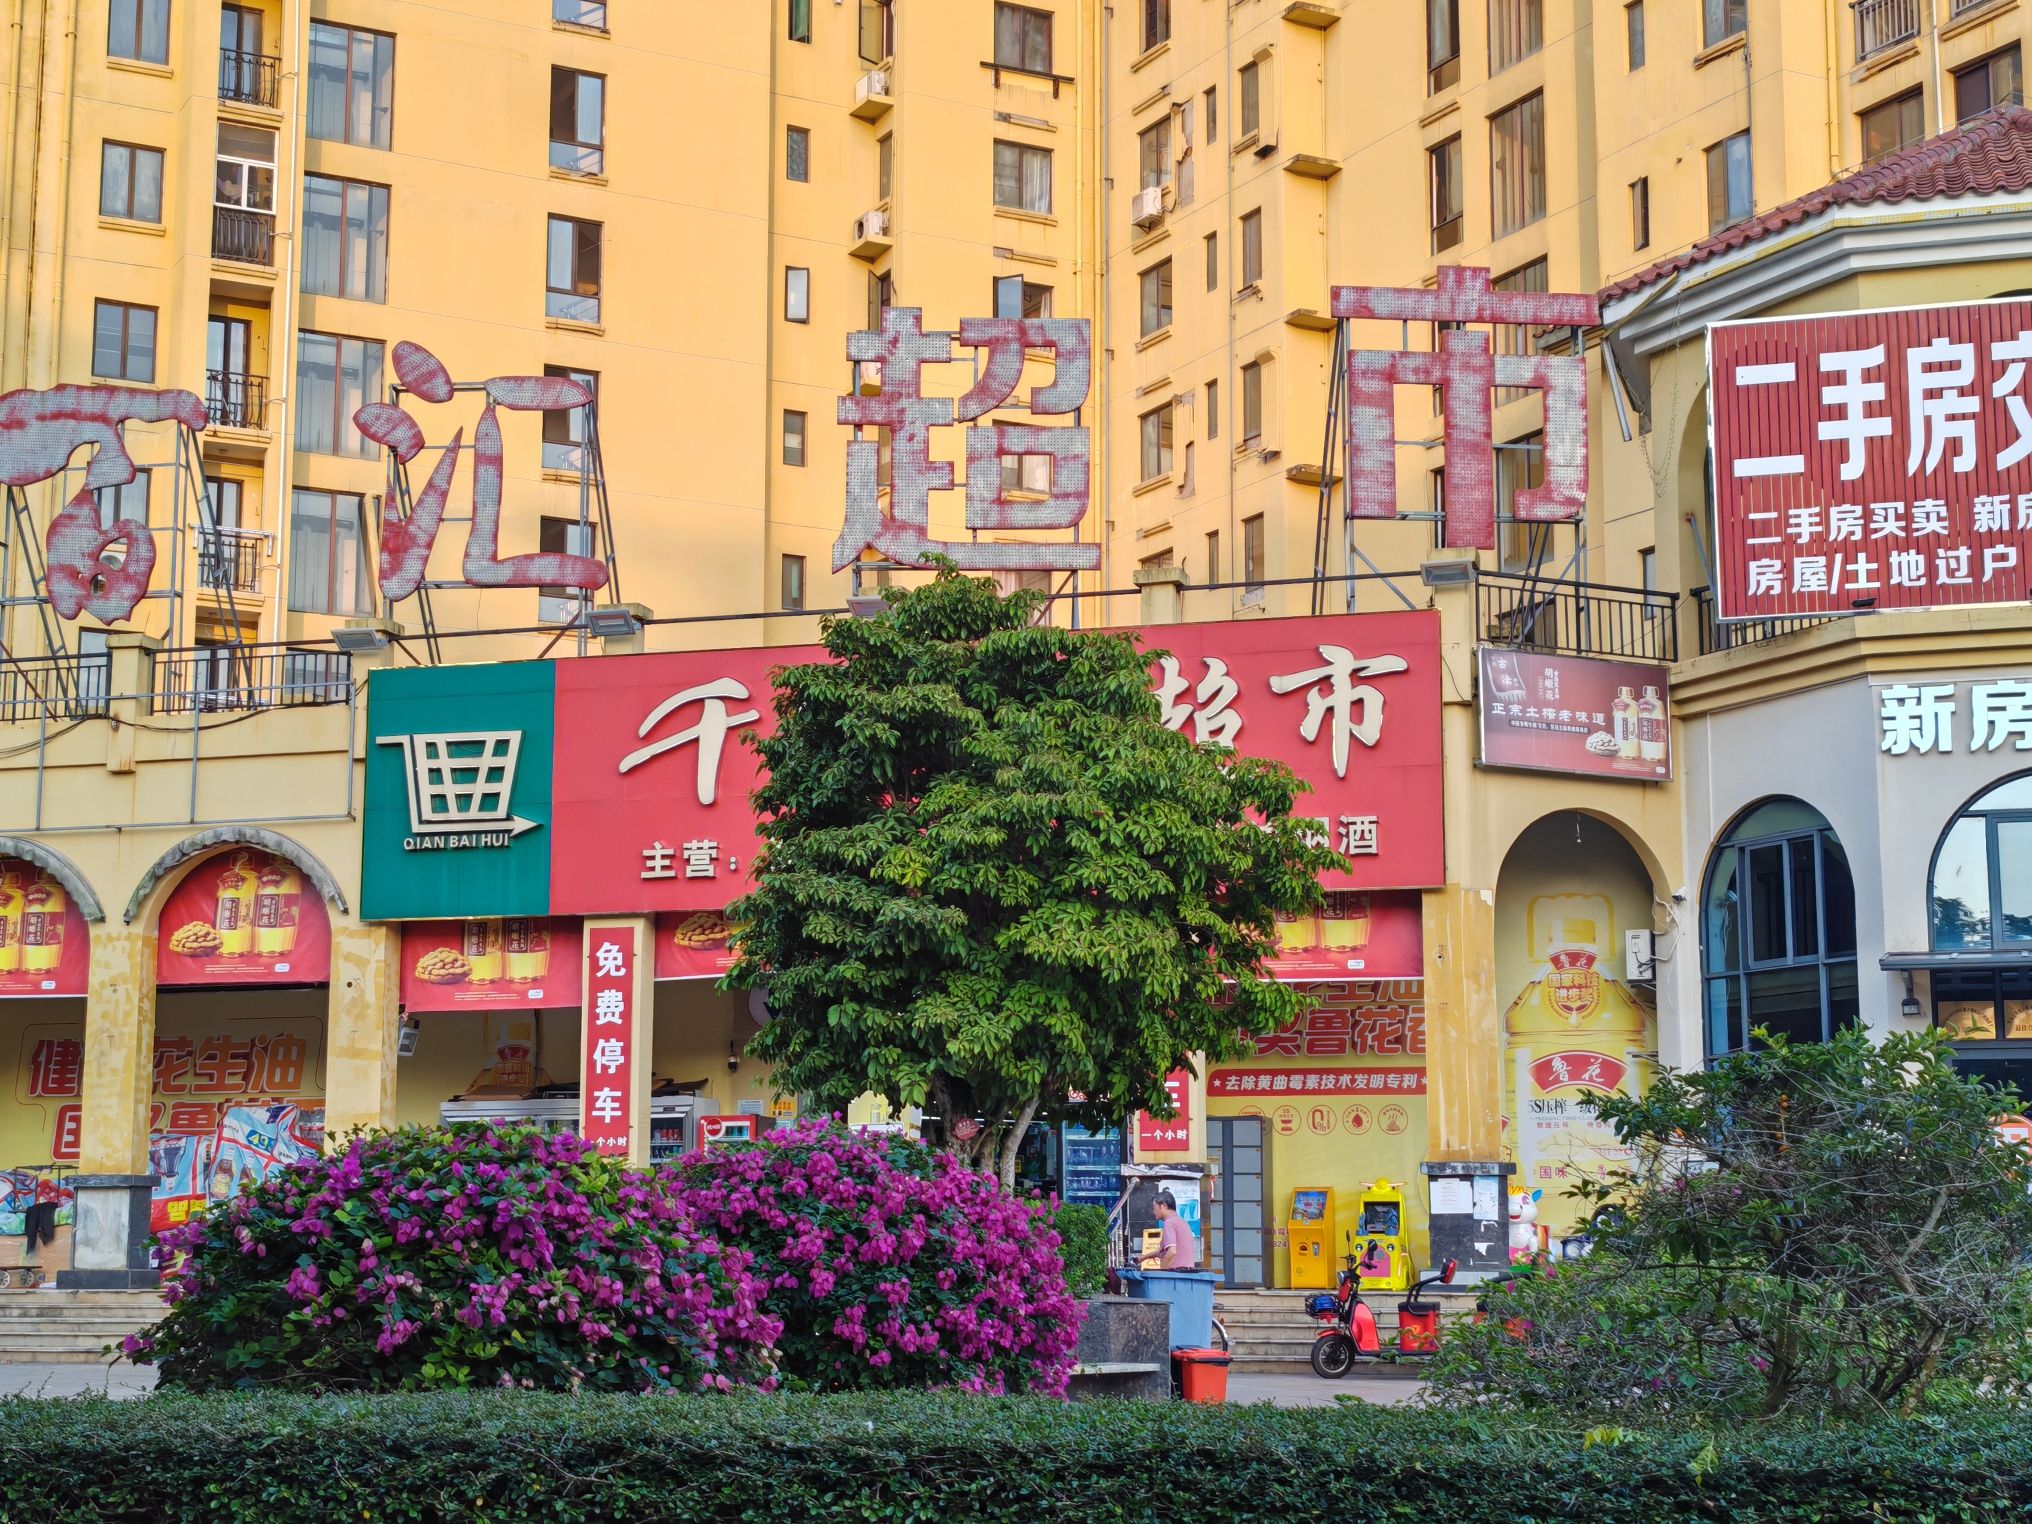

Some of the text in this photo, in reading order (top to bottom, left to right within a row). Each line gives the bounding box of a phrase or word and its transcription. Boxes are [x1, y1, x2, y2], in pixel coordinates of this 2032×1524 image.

[1747, 498, 1949, 545] 二手房买卖
[1747, 544, 2017, 596] 房屋/土地过户
[1491, 702, 1606, 726] 正宗土榨老味道
[403, 832, 510, 850] QIAN BAI HUI
[591, 941, 627, 1124] 免费停车
[1224, 1073, 1418, 1092] 去除黄曲霉素技术发明专利
[1141, 1128, 1188, 1141] 一个小时
